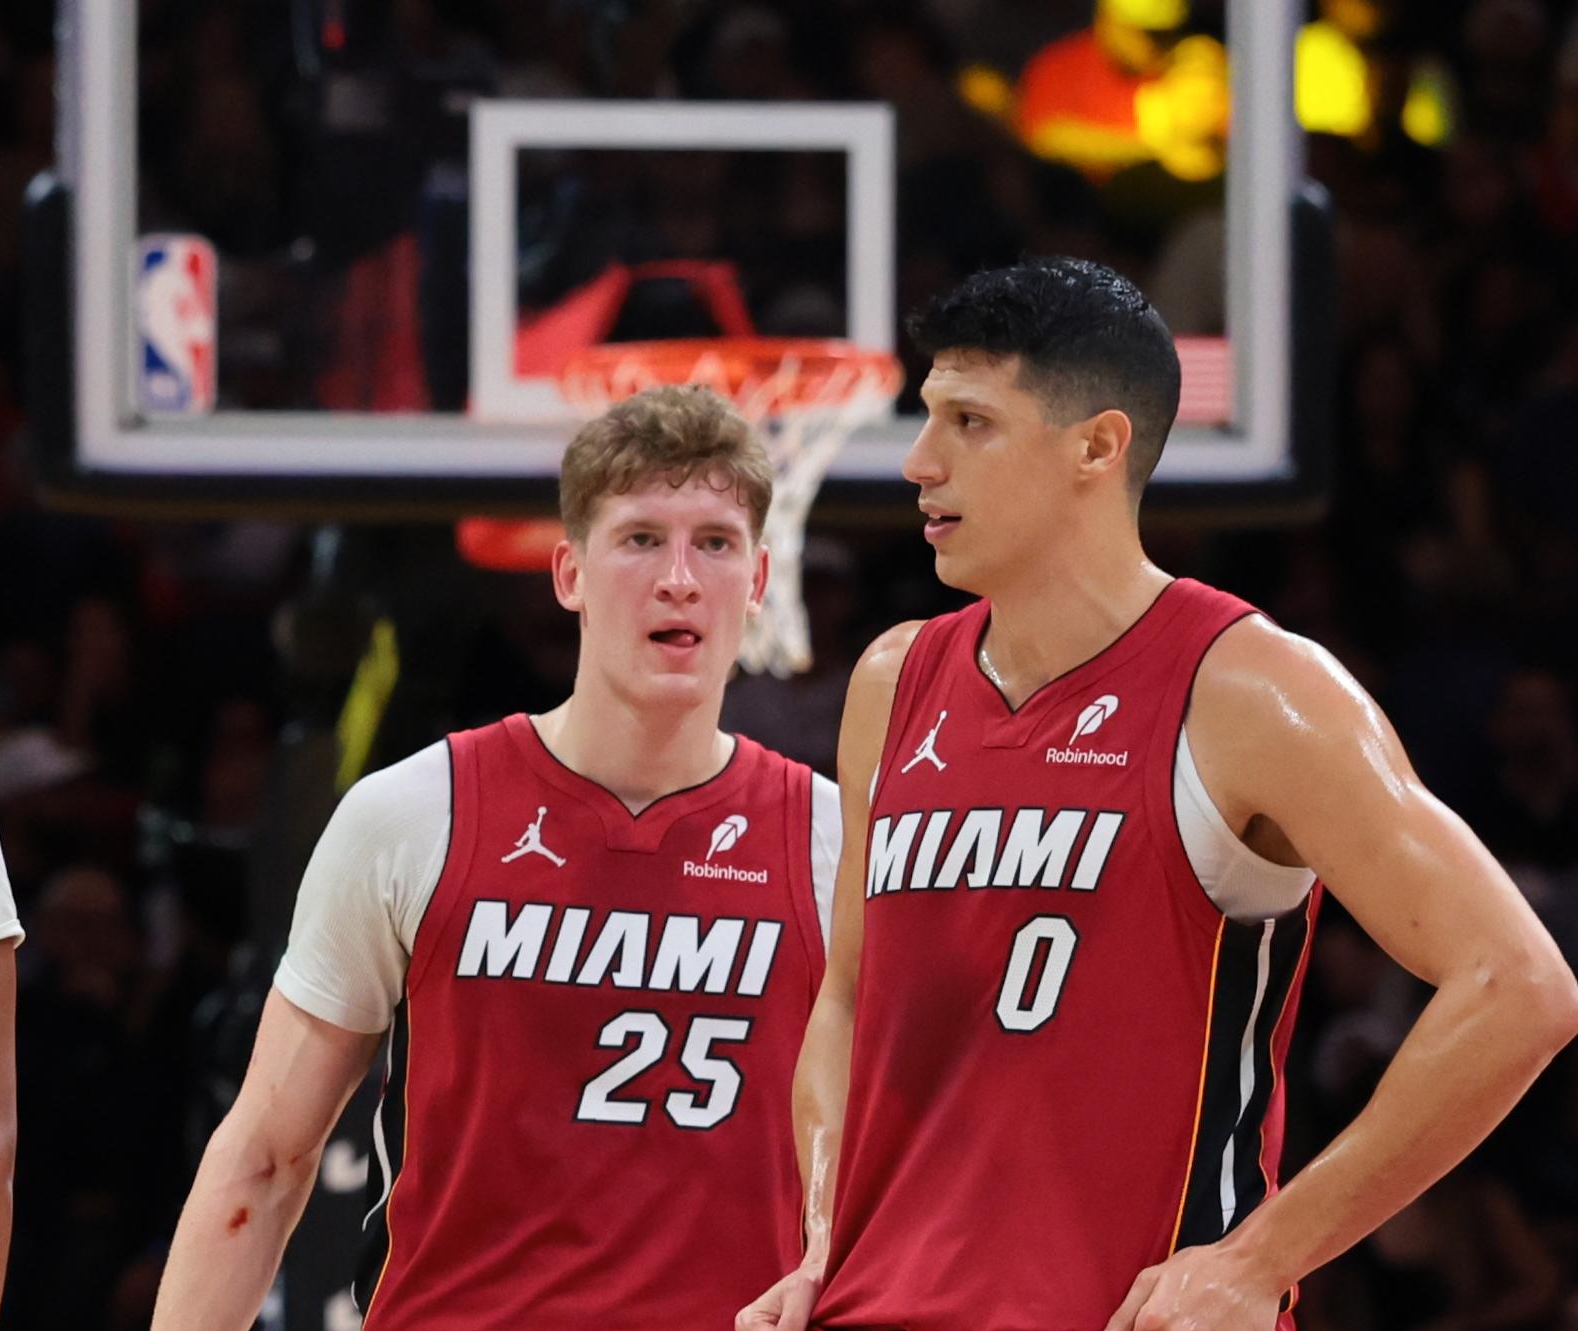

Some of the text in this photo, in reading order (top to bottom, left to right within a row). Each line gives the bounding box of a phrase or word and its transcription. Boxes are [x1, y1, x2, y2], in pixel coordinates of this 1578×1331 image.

[1045, 748, 1128, 767] Robinhood
[683, 861, 768, 884] Robinhood
[866, 808, 1127, 900] MIAMI
[455, 898, 783, 997] MIAMI
[994, 914, 1080, 1035] 0
[574, 1008, 755, 1130] 25
